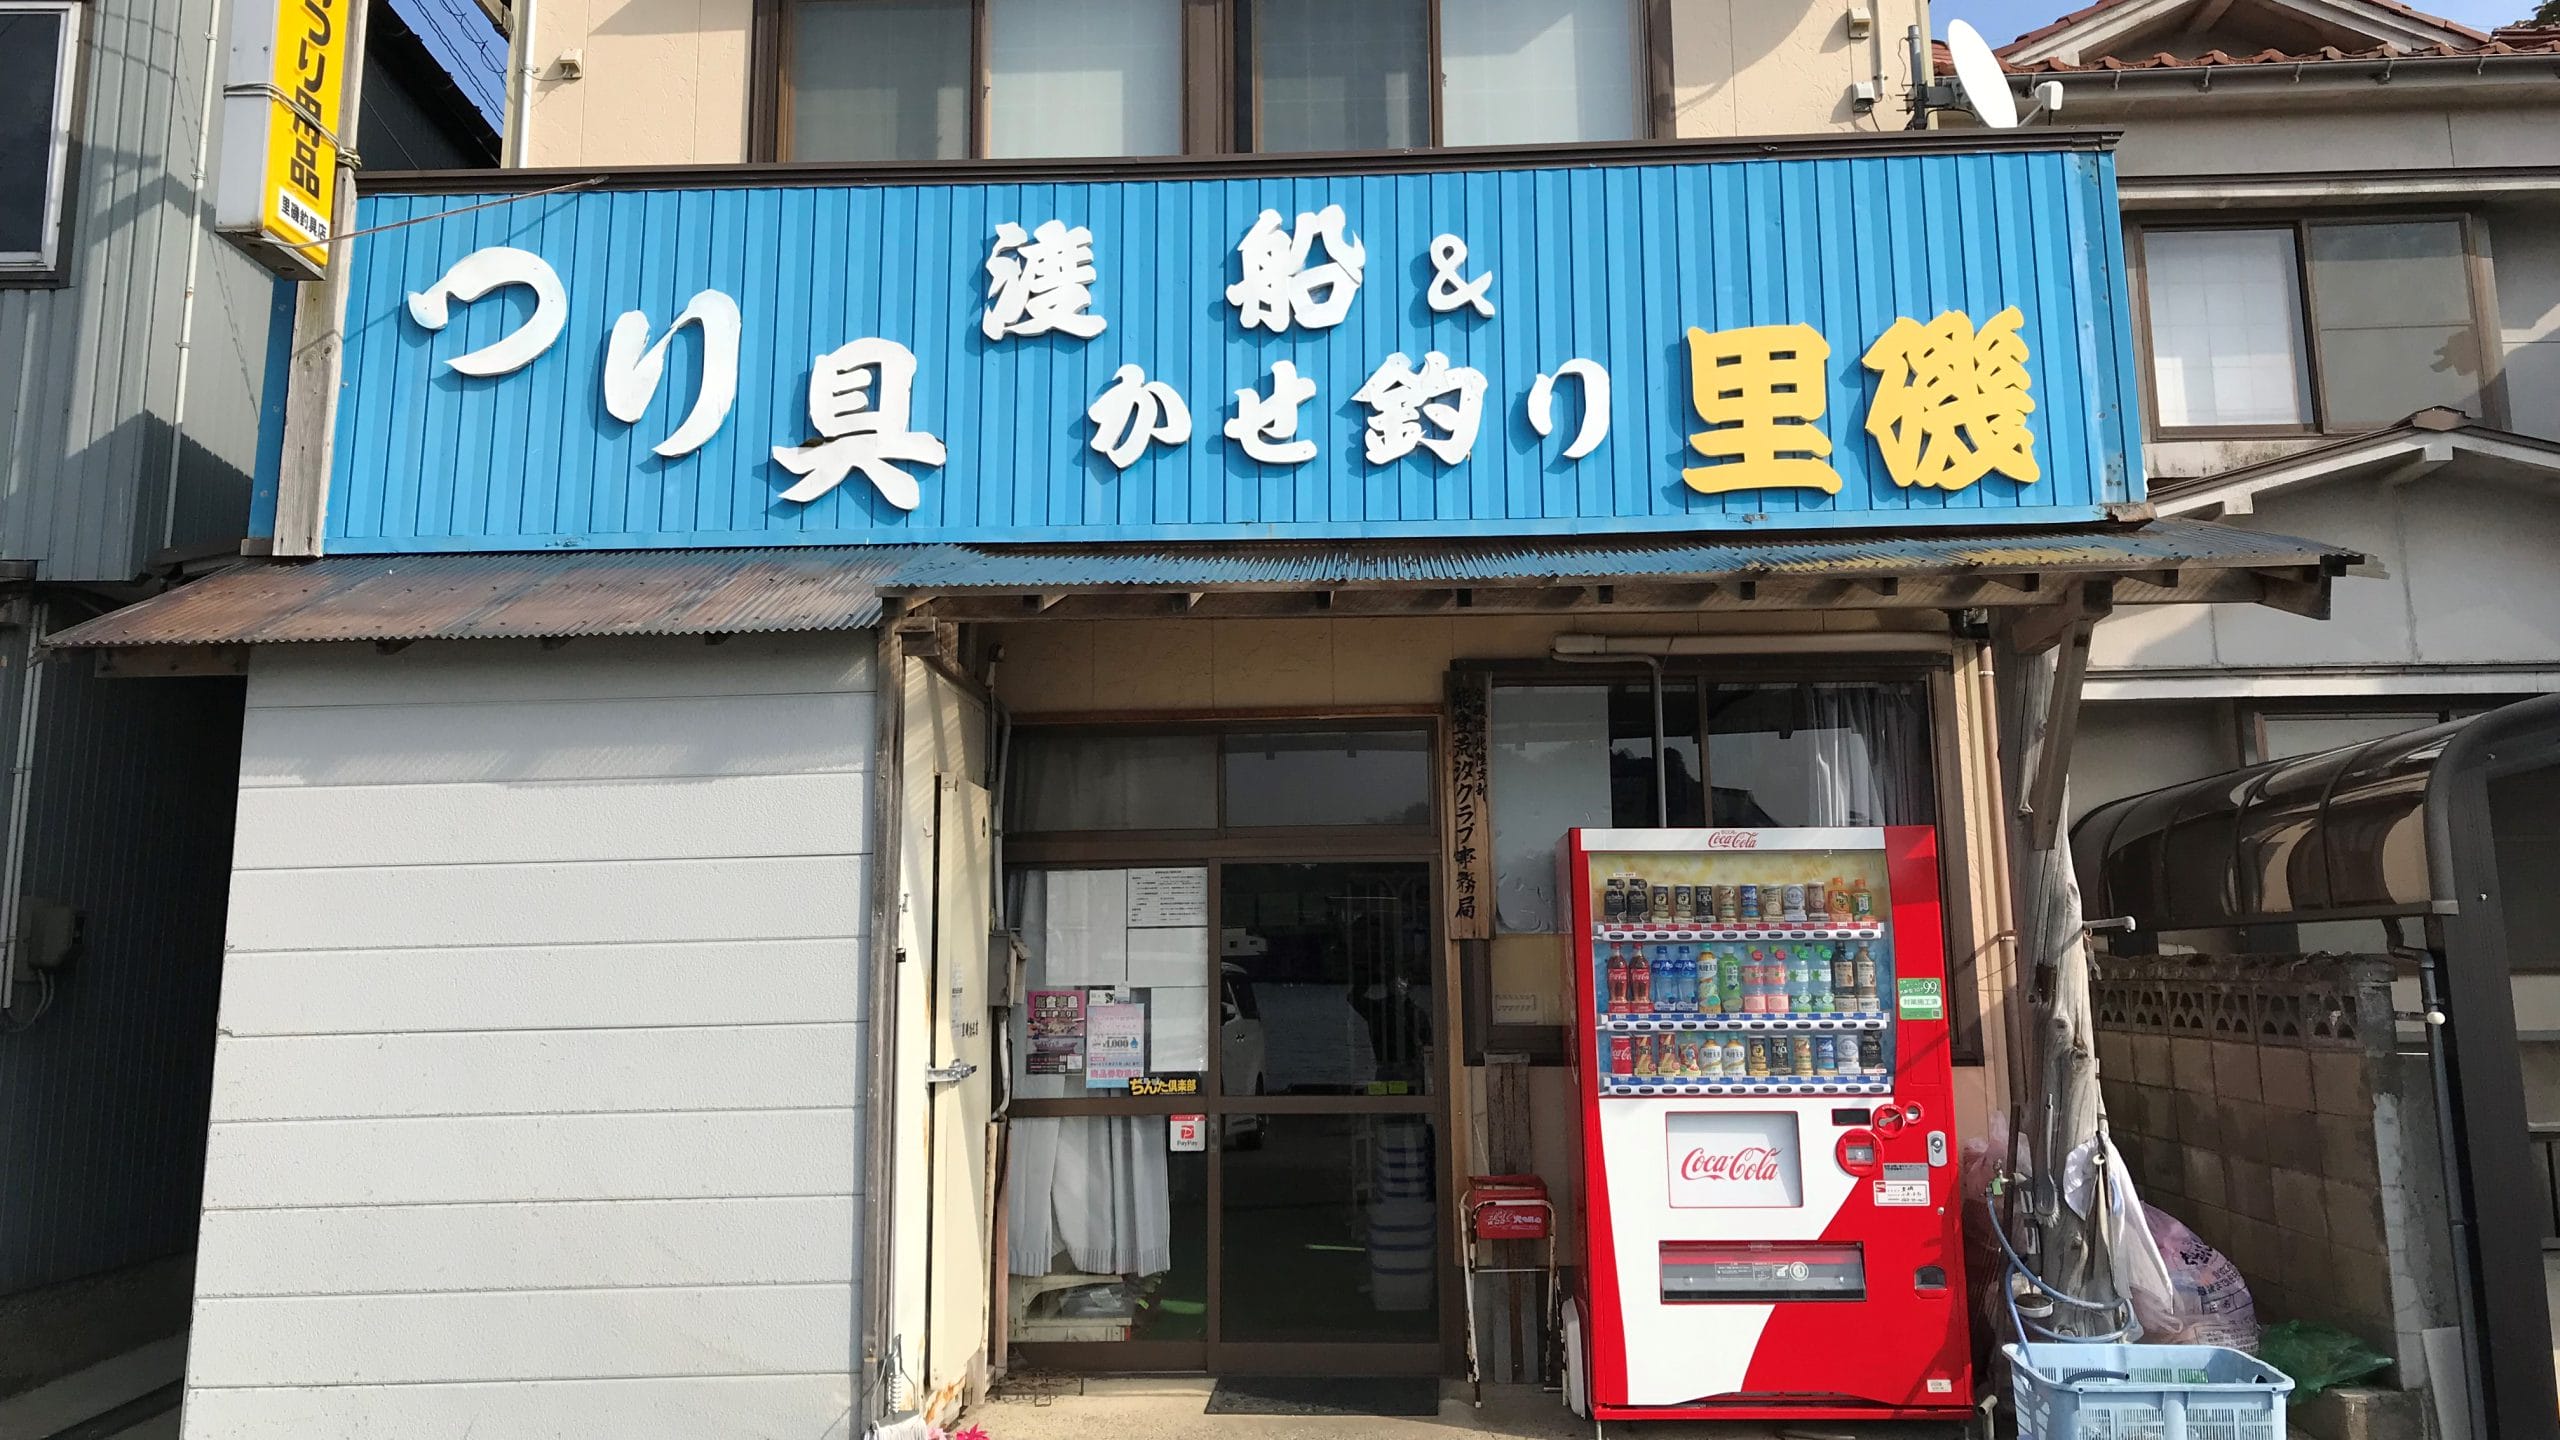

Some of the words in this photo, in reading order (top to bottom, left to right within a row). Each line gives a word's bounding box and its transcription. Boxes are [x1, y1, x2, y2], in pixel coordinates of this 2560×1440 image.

[982, 204, 1365, 340] 渡船
[1428, 233, 1495, 318] &
[408, 246, 946, 510] つり具
[1088, 350, 1611, 468] かせ釣り
[1682, 305, 2040, 494] 里磯
[1708, 831, 1759, 848] Coca-Cola
[1176, 1140, 1199, 1148] PayPay
[1681, 1147, 1783, 1181] Coca-Cola
